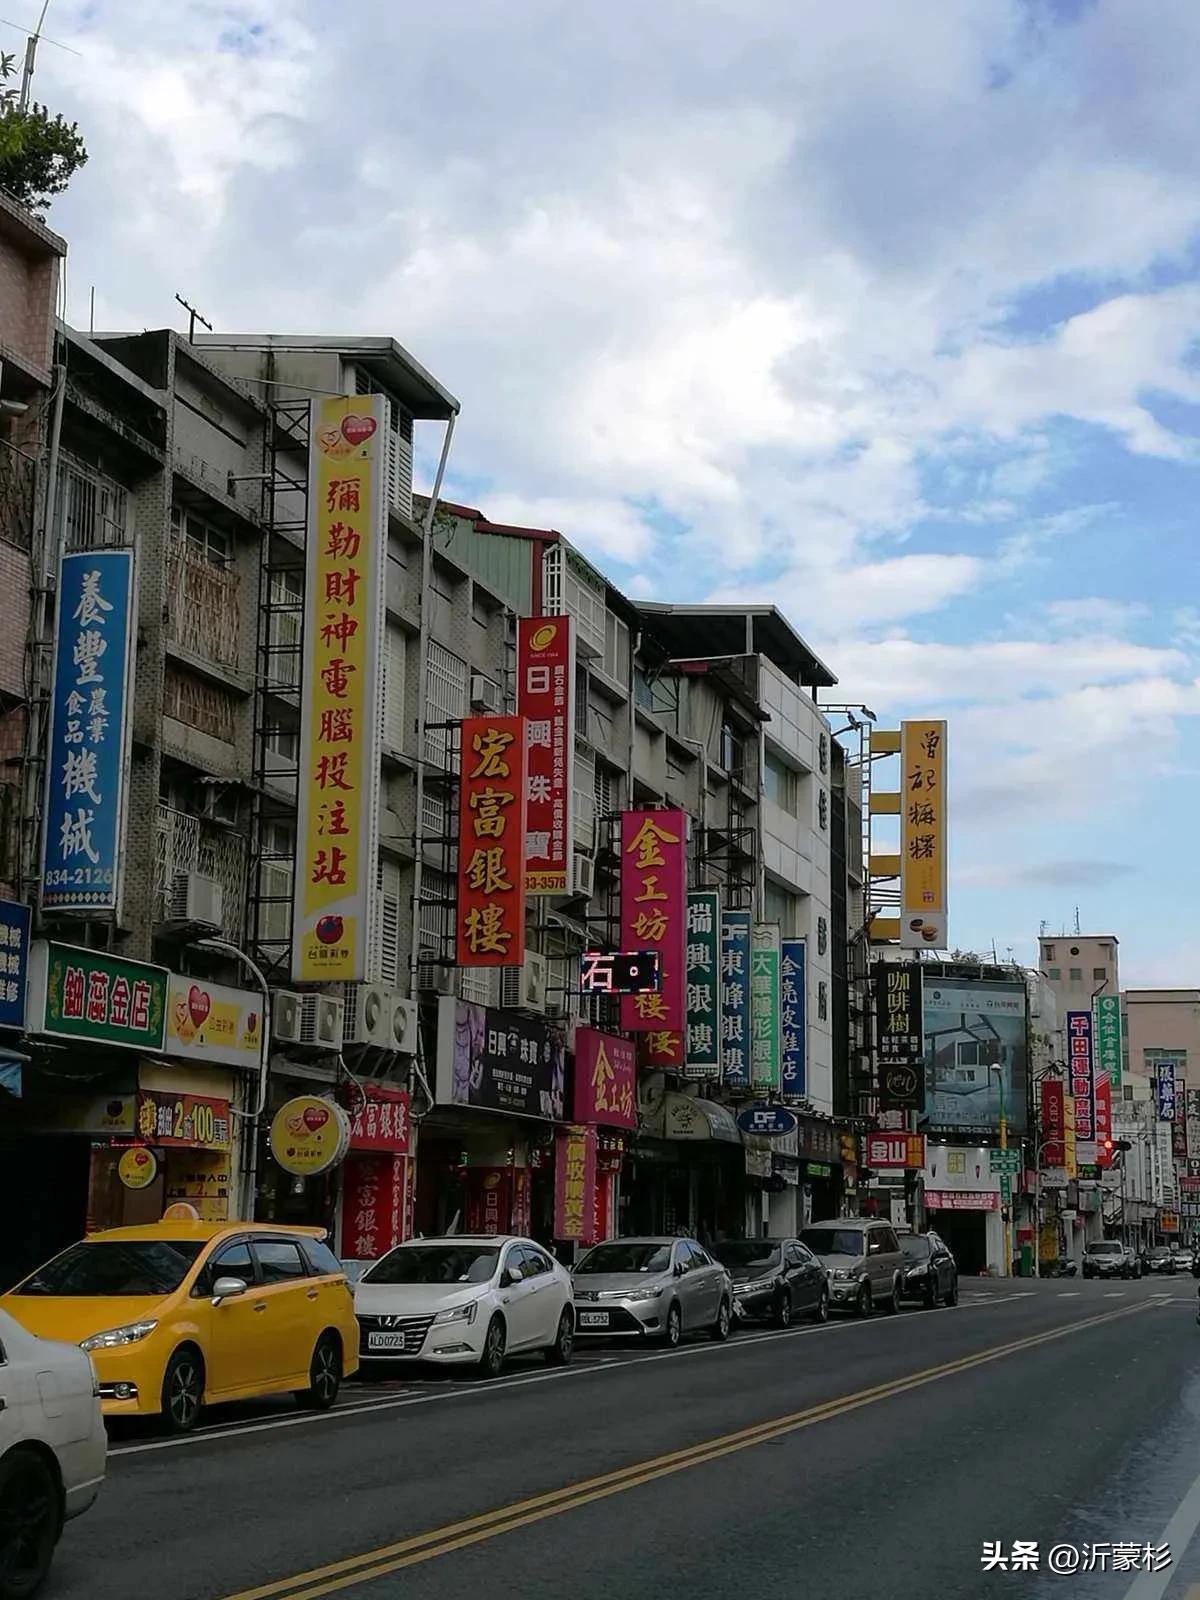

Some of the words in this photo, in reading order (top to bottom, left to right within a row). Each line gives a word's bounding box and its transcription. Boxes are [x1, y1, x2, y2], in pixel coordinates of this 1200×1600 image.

[311, 477, 362, 886] 彌勒財神電腦投注站
[46, 867, 113, 887] 834-2126
[464, 727, 515, 955] 宏富銀樓
[626, 817, 680, 1022] 金工坊樓
[887, 970, 911, 1034] 咖啡樹
[1069, 1016, 1093, 1139] 千田運動廣場
